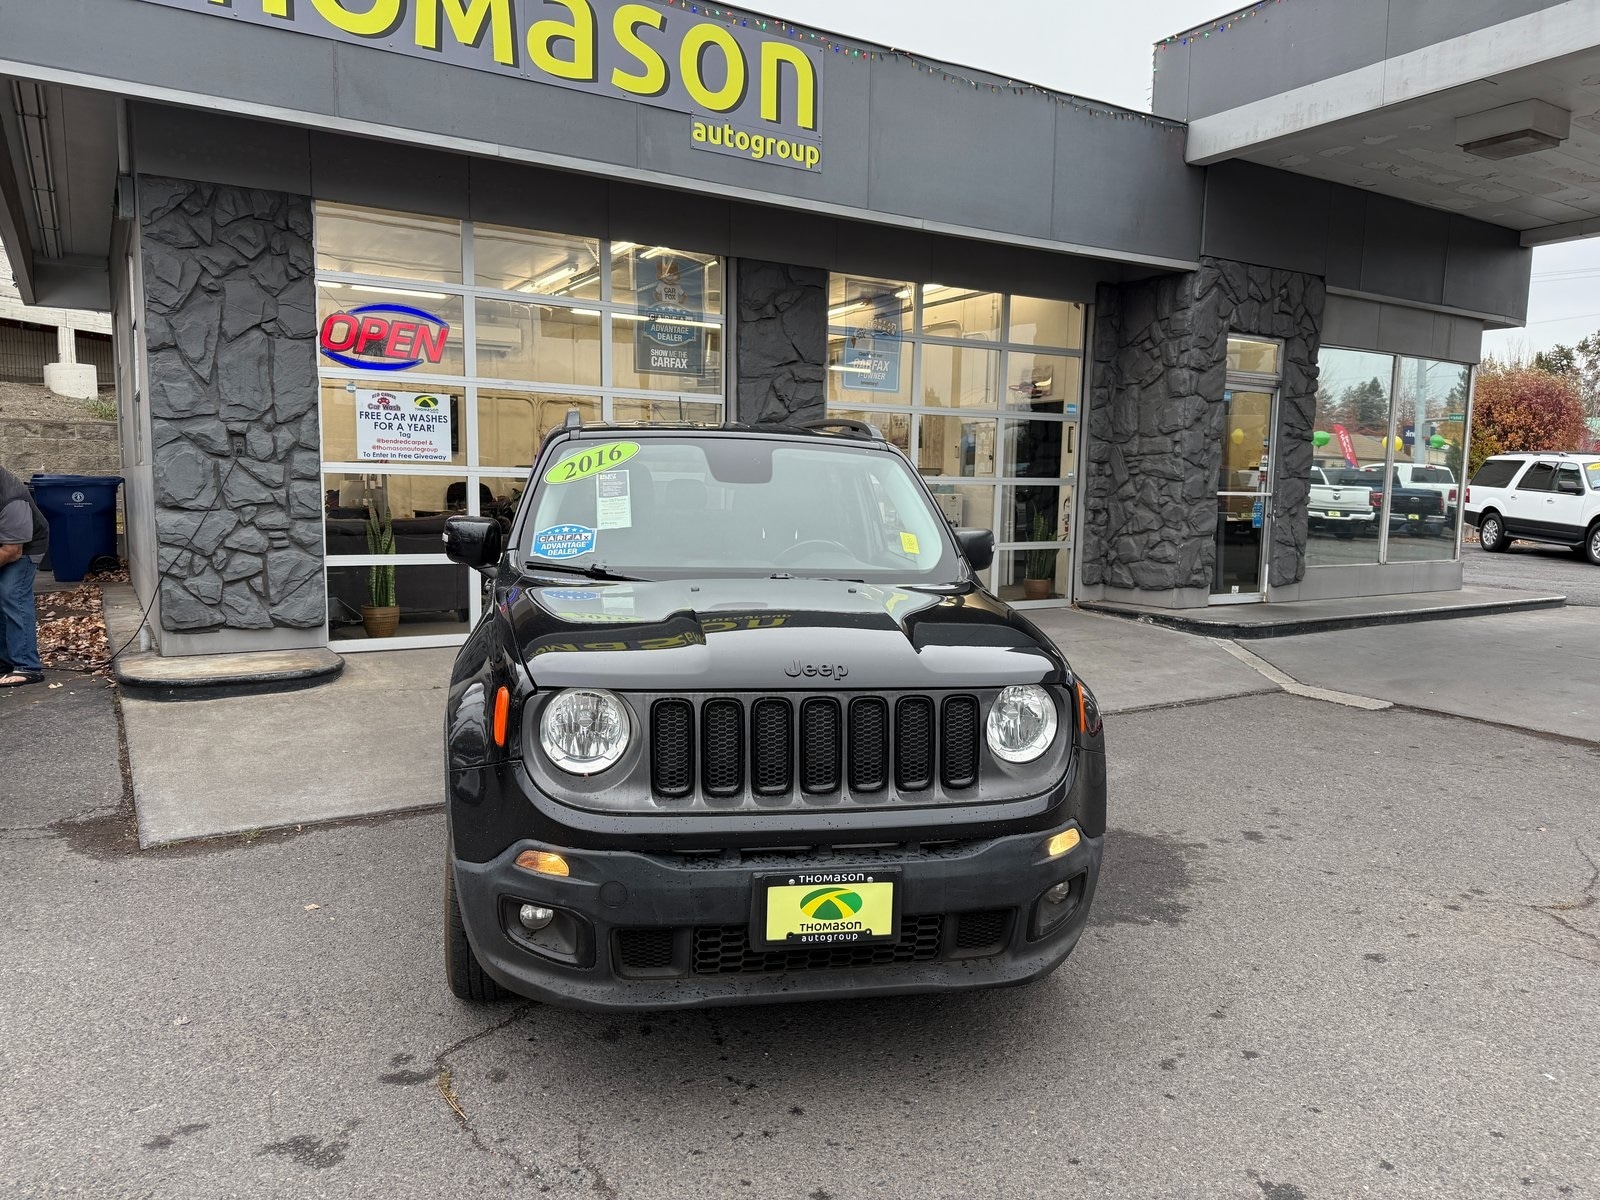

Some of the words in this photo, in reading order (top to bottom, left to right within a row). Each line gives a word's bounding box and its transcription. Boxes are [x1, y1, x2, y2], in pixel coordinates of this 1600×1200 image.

[693, 120, 820, 168] autogroup
[651, 324, 689, 334] ADVANTAGE
[320, 312, 448, 363] OPEN
[657, 333, 683, 342] DEALER
[650, 349, 668, 357] SHOW
[651, 356, 688, 369] CARFAX
[360, 411, 381, 420] FREE
[384, 412, 406, 422] CAR
[409, 413, 448, 424] WASHES
[374, 421, 393, 431] FOR
[397, 423, 404, 431] A
[407, 423, 435, 432] YEAR!
[413, 453, 447, 461] Giveaway
[563, 444, 622, 480] 2016
[539, 532, 591, 543] CARFAX
[541, 541, 587, 551] ADVANTAGE
[547, 548, 578, 556] DEALER
[784, 659, 848, 680] Jeep
[801, 932, 859, 943] autogroup
